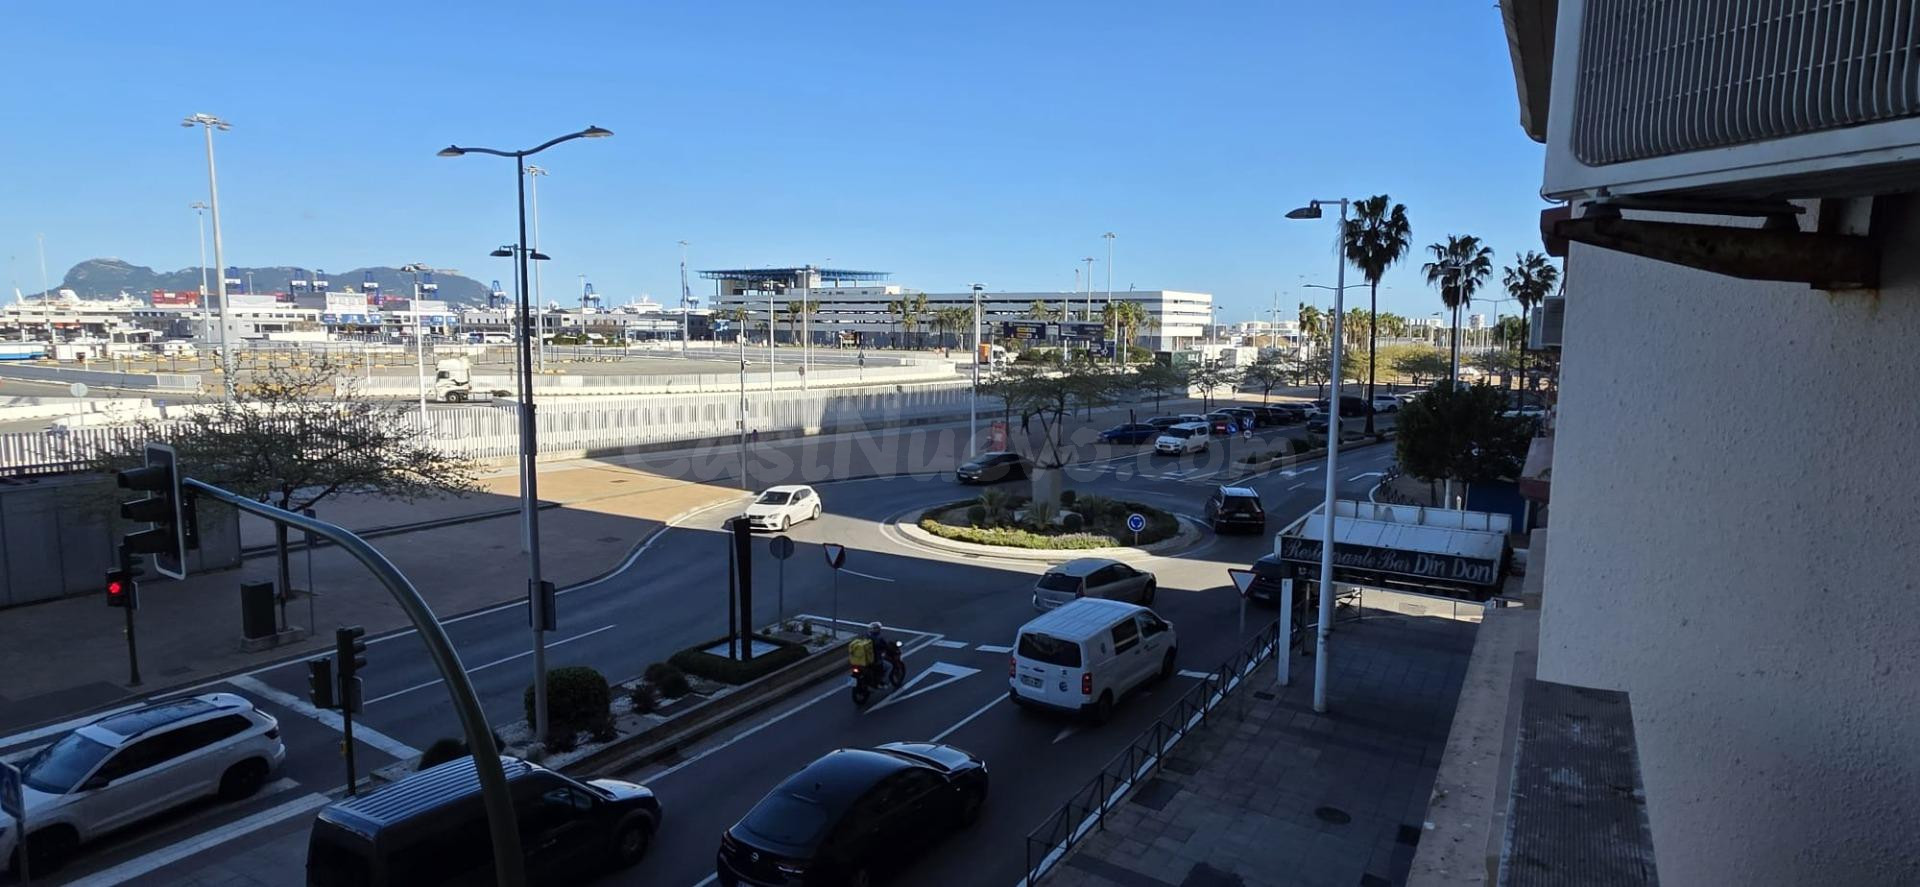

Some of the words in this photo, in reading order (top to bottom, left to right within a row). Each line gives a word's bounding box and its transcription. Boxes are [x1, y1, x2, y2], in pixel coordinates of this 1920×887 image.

[1284, 539, 1376, 568] Restarante
[1377, 550, 1410, 572] Bar
[1414, 553, 1446, 576] Din
[1452, 558, 1490, 582] Don
